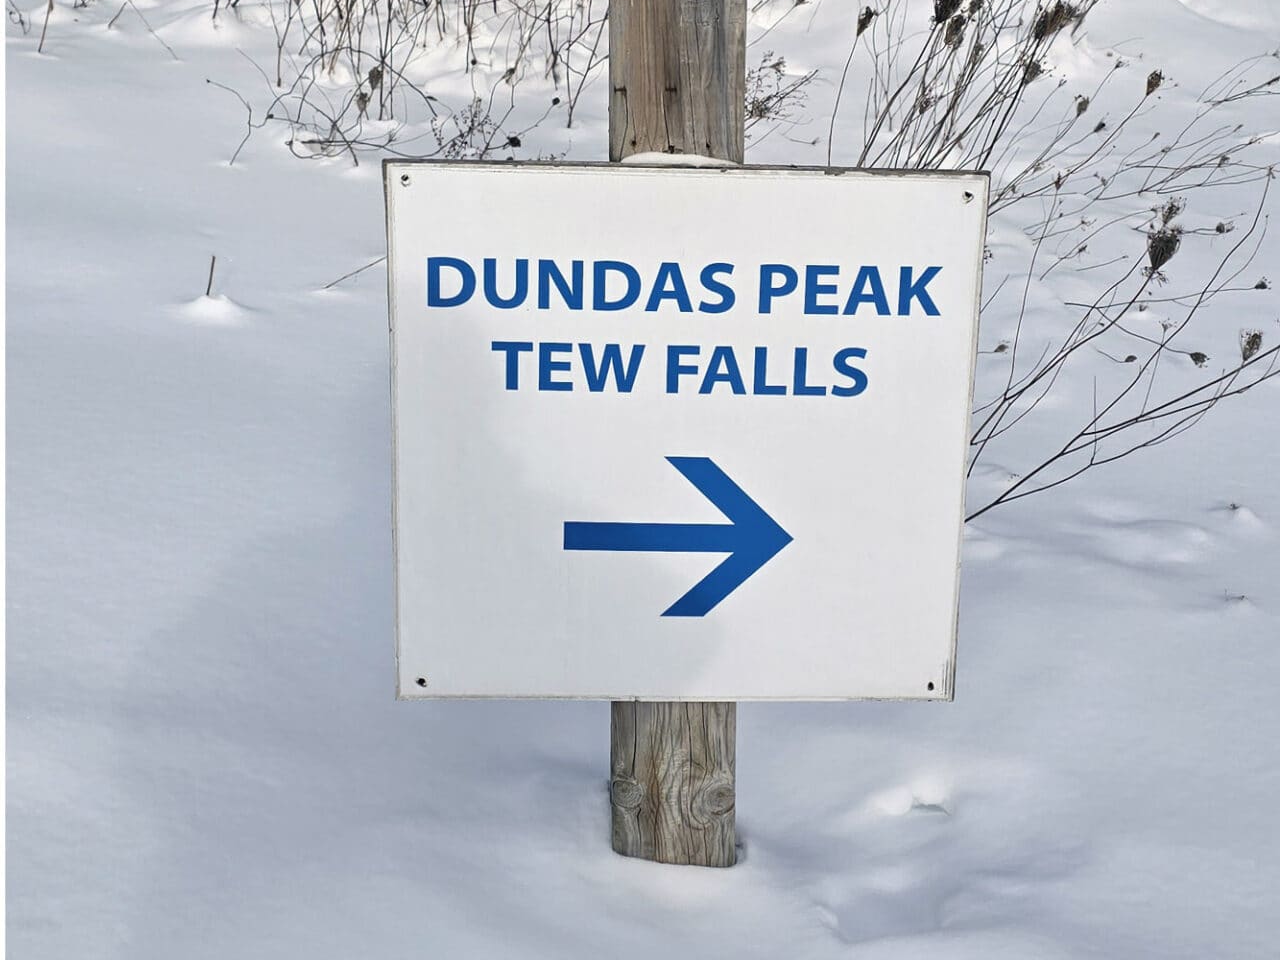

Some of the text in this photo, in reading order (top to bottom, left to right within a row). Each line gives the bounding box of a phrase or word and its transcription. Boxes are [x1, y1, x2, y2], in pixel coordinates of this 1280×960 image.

[427, 257, 943, 316] DUNDAS PEAK
[492, 341, 868, 397] TEW FALLS
